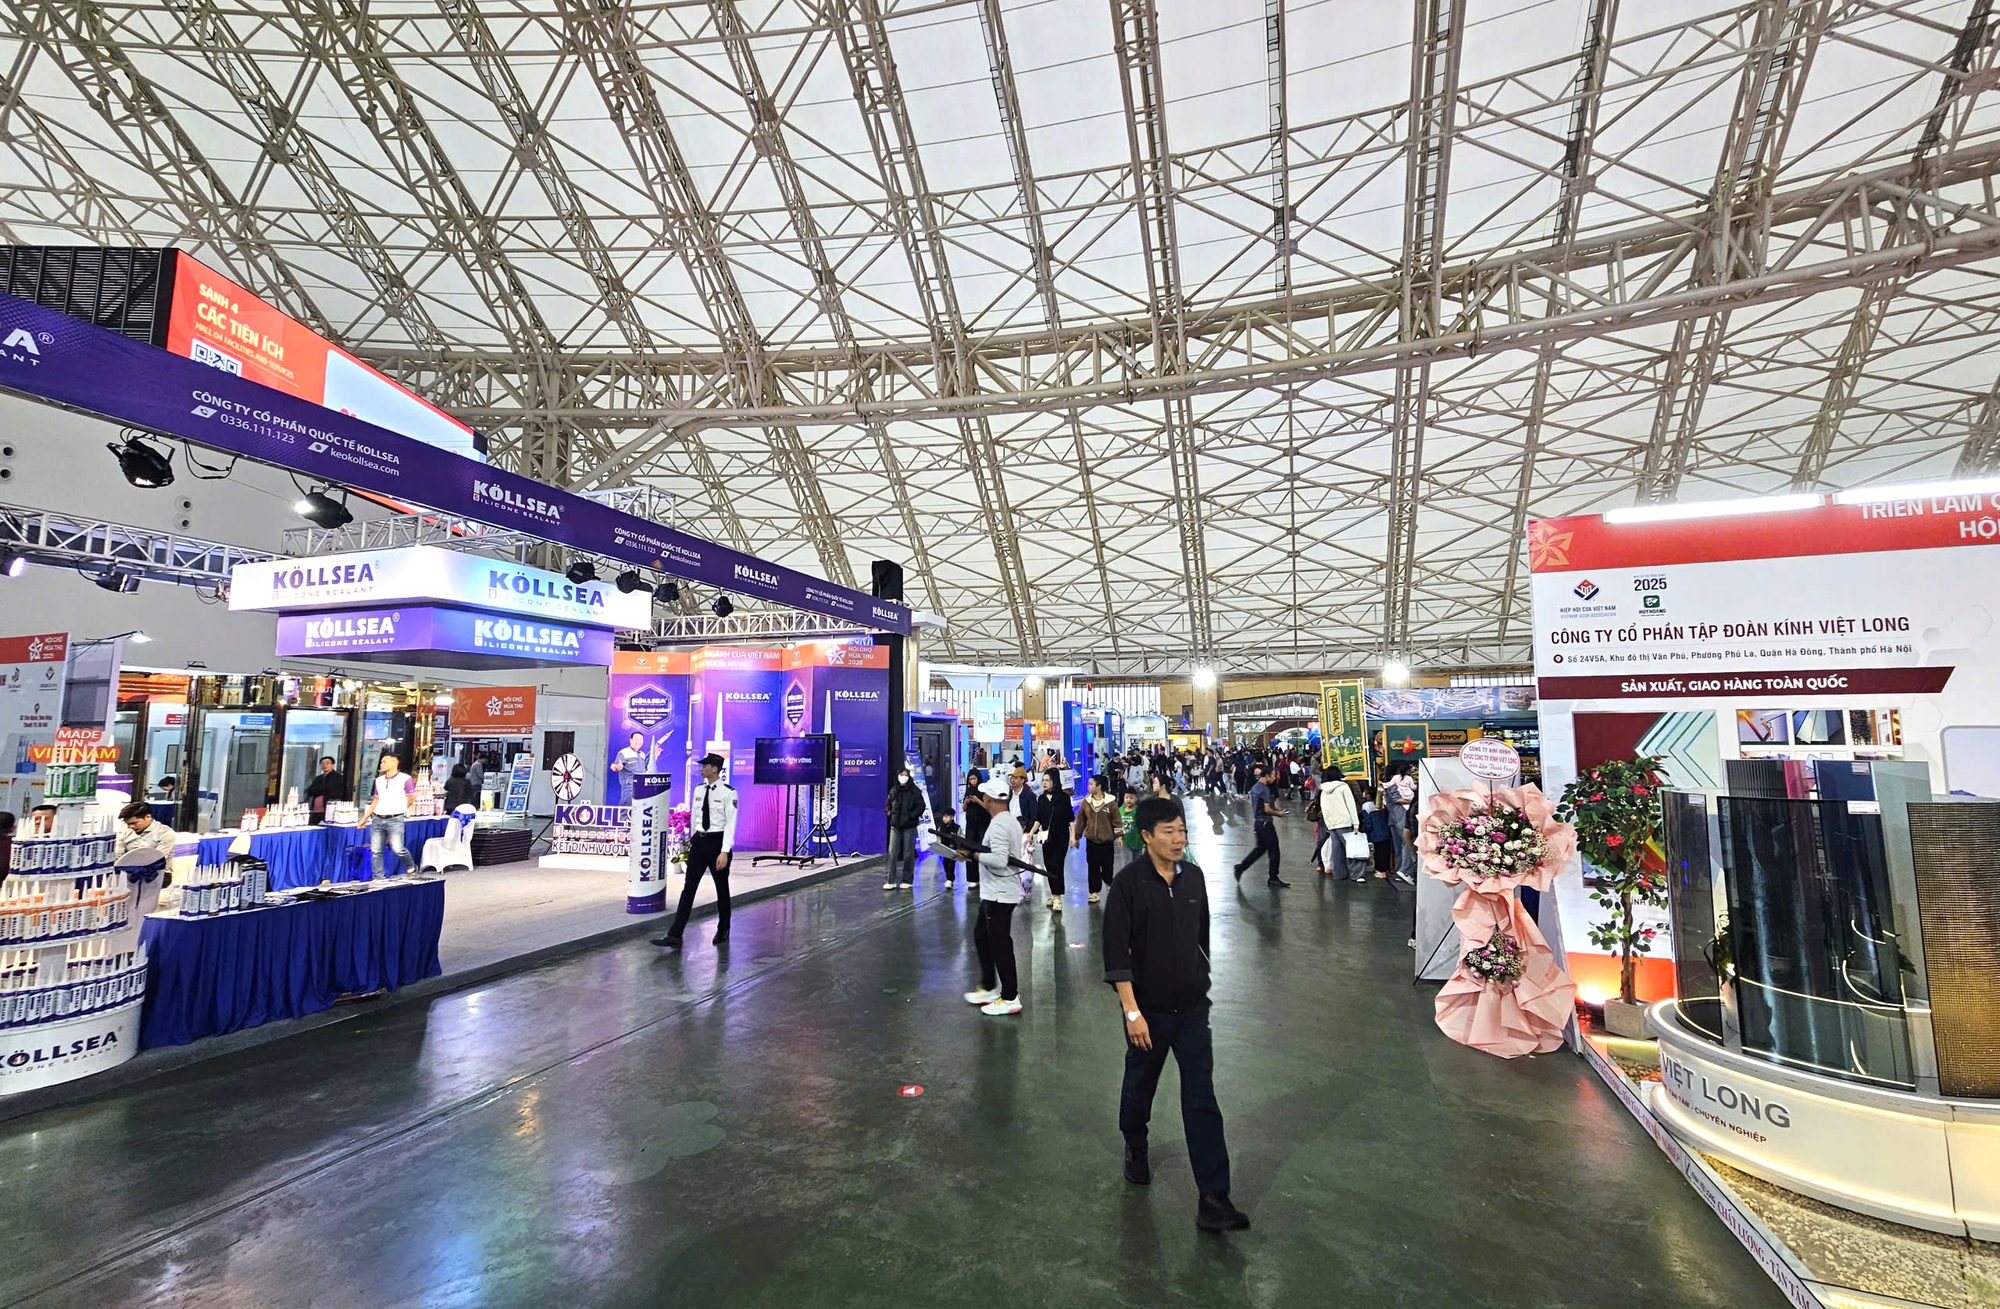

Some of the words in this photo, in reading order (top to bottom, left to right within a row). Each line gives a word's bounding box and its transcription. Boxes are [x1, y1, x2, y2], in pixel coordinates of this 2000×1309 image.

[230, 303, 239, 315] 4
[197, 303, 227, 330] CÁC
[229, 319, 259, 348] TIỆN
[261, 334, 284, 360] ÍCH
[195, 322, 213, 337] HALL
[213, 331, 223, 342] 04
[223, 336, 255, 358] FACILITIES
[255, 352, 268, 365] AND
[268, 360, 295, 379] SERVICES
[192, 390, 232, 411] CÔNG
[233, 402, 251, 416] TY
[308, 428, 342, 446] QUỐC
[356, 443, 400, 465] KOLLSEA
[220, 413, 295, 444] 0336.111.123
[330, 447, 400, 477] keokollsea.com
[473, 492, 519, 514] SILICONE
[522, 511, 561, 526] SEALANT
[630, 532, 638, 540] TY
[1633, 577, 1668, 591] 2025
[1551, 628, 1590, 645] CÔNG
[1595, 629, 1613, 643] TY
[1618, 622, 1638, 642] CỔ
[1642, 621, 1684, 641] PHẦN
[1688, 621, 1718, 642] TẬP
[1723, 619, 1768, 638] ĐOÀN
[1774, 617, 1814, 636] KÍNH
[1818, 616, 1856, 637] VIỆT
[1862, 616, 1910, 633] LONG
[1579, 655, 1608, 664] 24V5A,
[1609, 654, 1625, 662] Khu
[1639, 653, 1650, 662] thị
[1860, 645, 1877, 655] phố
[1896, 644, 1913, 653] Nội
[1621, 678, 1647, 693] SẢN
[1649, 677, 1686, 693] XUẤT,
[1688, 678, 1721, 691] GIAO
[1723, 676, 1762, 691] HÀNG
[1764, 675, 1804, 689] TOÀN
[1806, 673, 1848, 691] QUỐC
[58, 730, 101, 739] MADE
[69, 739, 84, 747] IN
[856, 758, 863, 766] ÉP
[63, 1045, 118, 1065] SEALANT
[1661, 1052, 1696, 1090] VIỆT
[1702, 1077, 1790, 1128] LONG
[1694, 1106, 1726, 1128] CHUYÊN
[1728, 1124, 1767, 1143] NGHIỆP
[1716, 1201, 1738, 1230] CHẤT
[1737, 1223, 1766, 1263] LƯỢNG
[1769, 1259, 1789, 1289] TẬN
